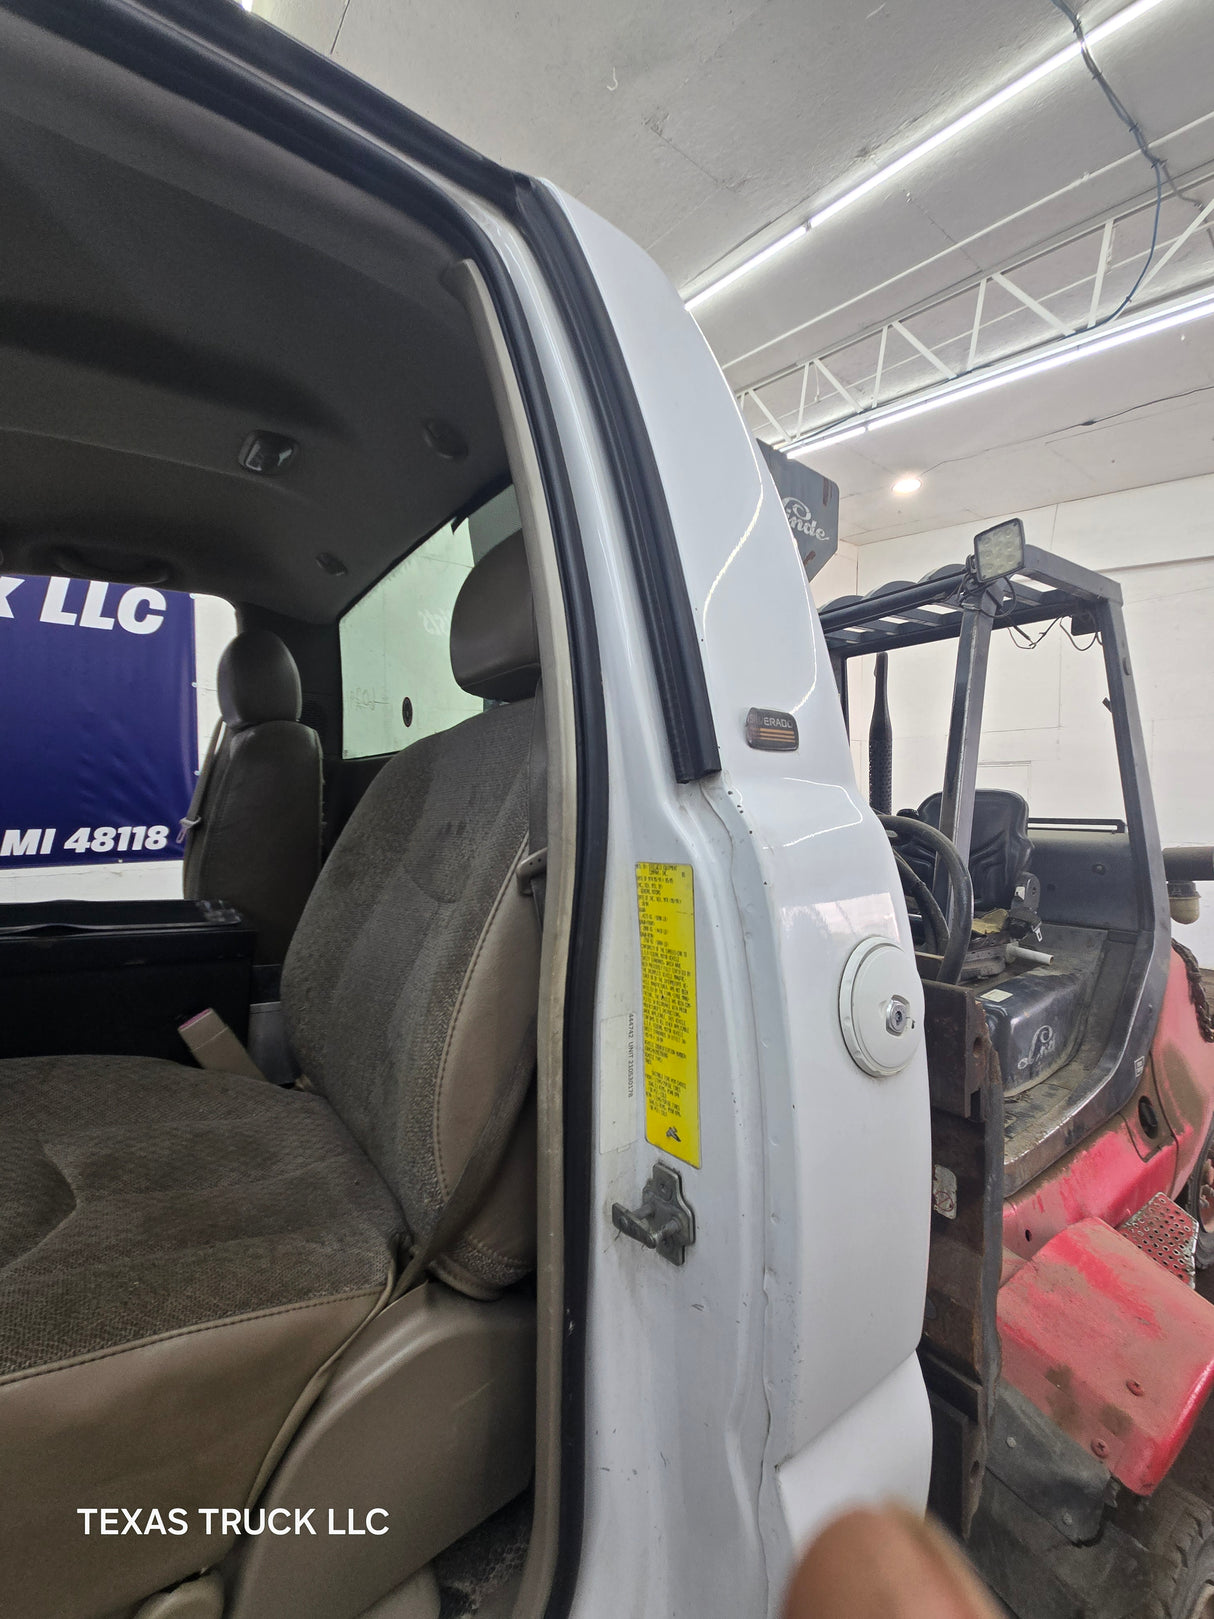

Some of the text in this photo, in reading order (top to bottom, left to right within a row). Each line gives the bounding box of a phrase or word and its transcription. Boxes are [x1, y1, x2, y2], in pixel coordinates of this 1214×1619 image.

[781, 496, 830, 541] nde
[40, 576, 167, 635] LLC
[0, 825, 170, 857] MI 48118
